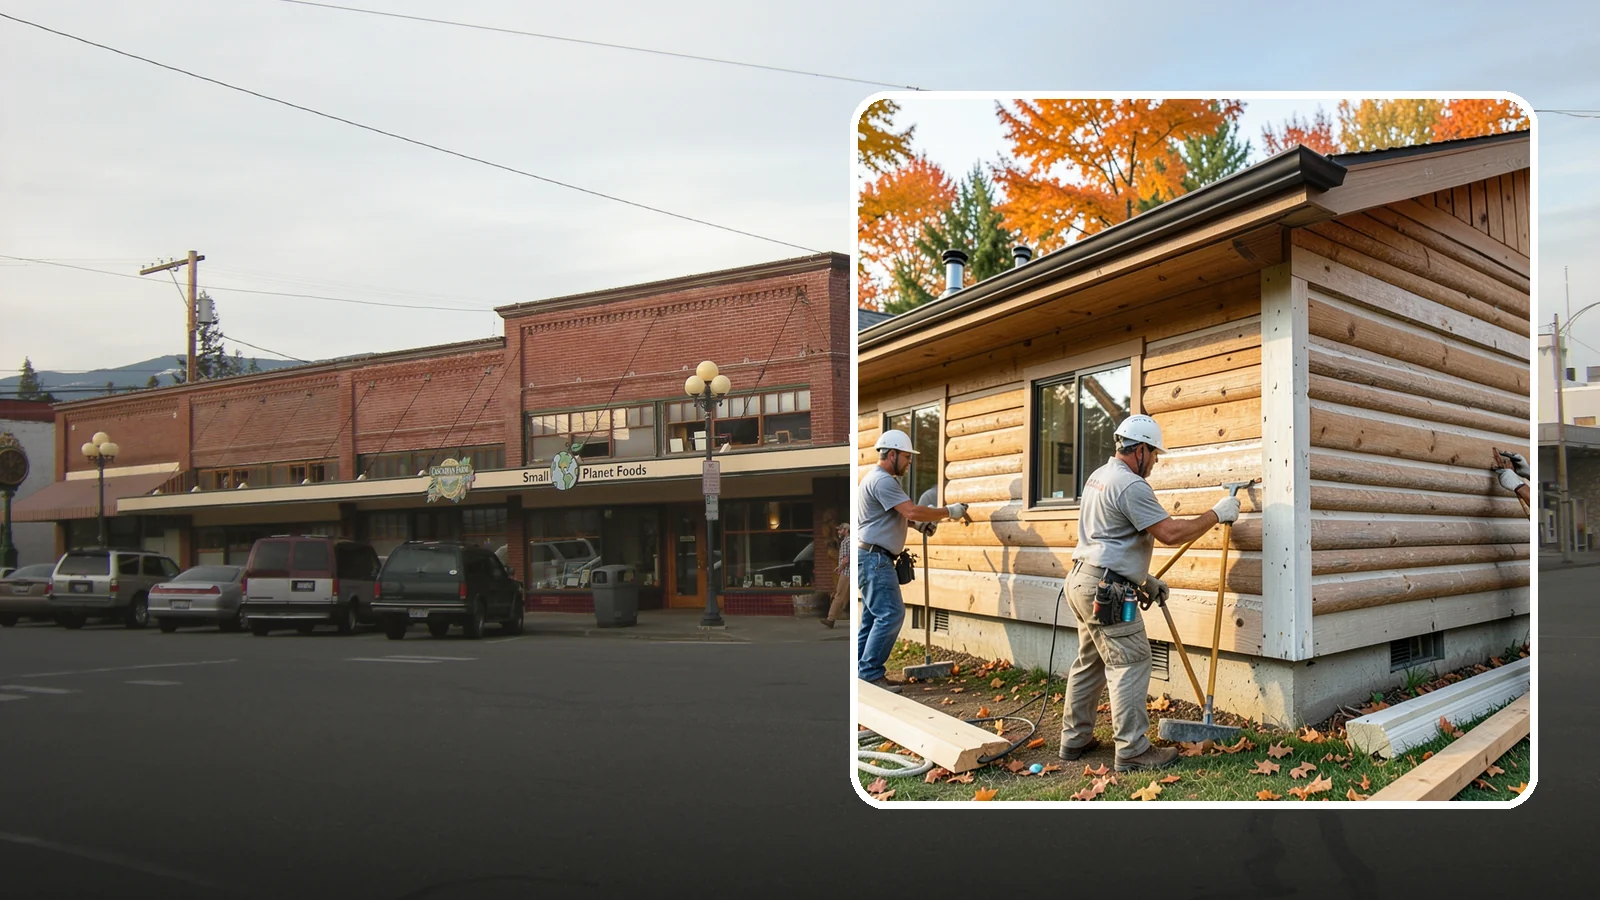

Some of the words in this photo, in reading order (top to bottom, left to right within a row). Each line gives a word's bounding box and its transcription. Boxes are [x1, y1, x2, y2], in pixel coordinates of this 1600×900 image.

[523, 471, 549, 483] Small
[583, 468, 614, 479] Planet
[617, 464, 647, 477] Foods
